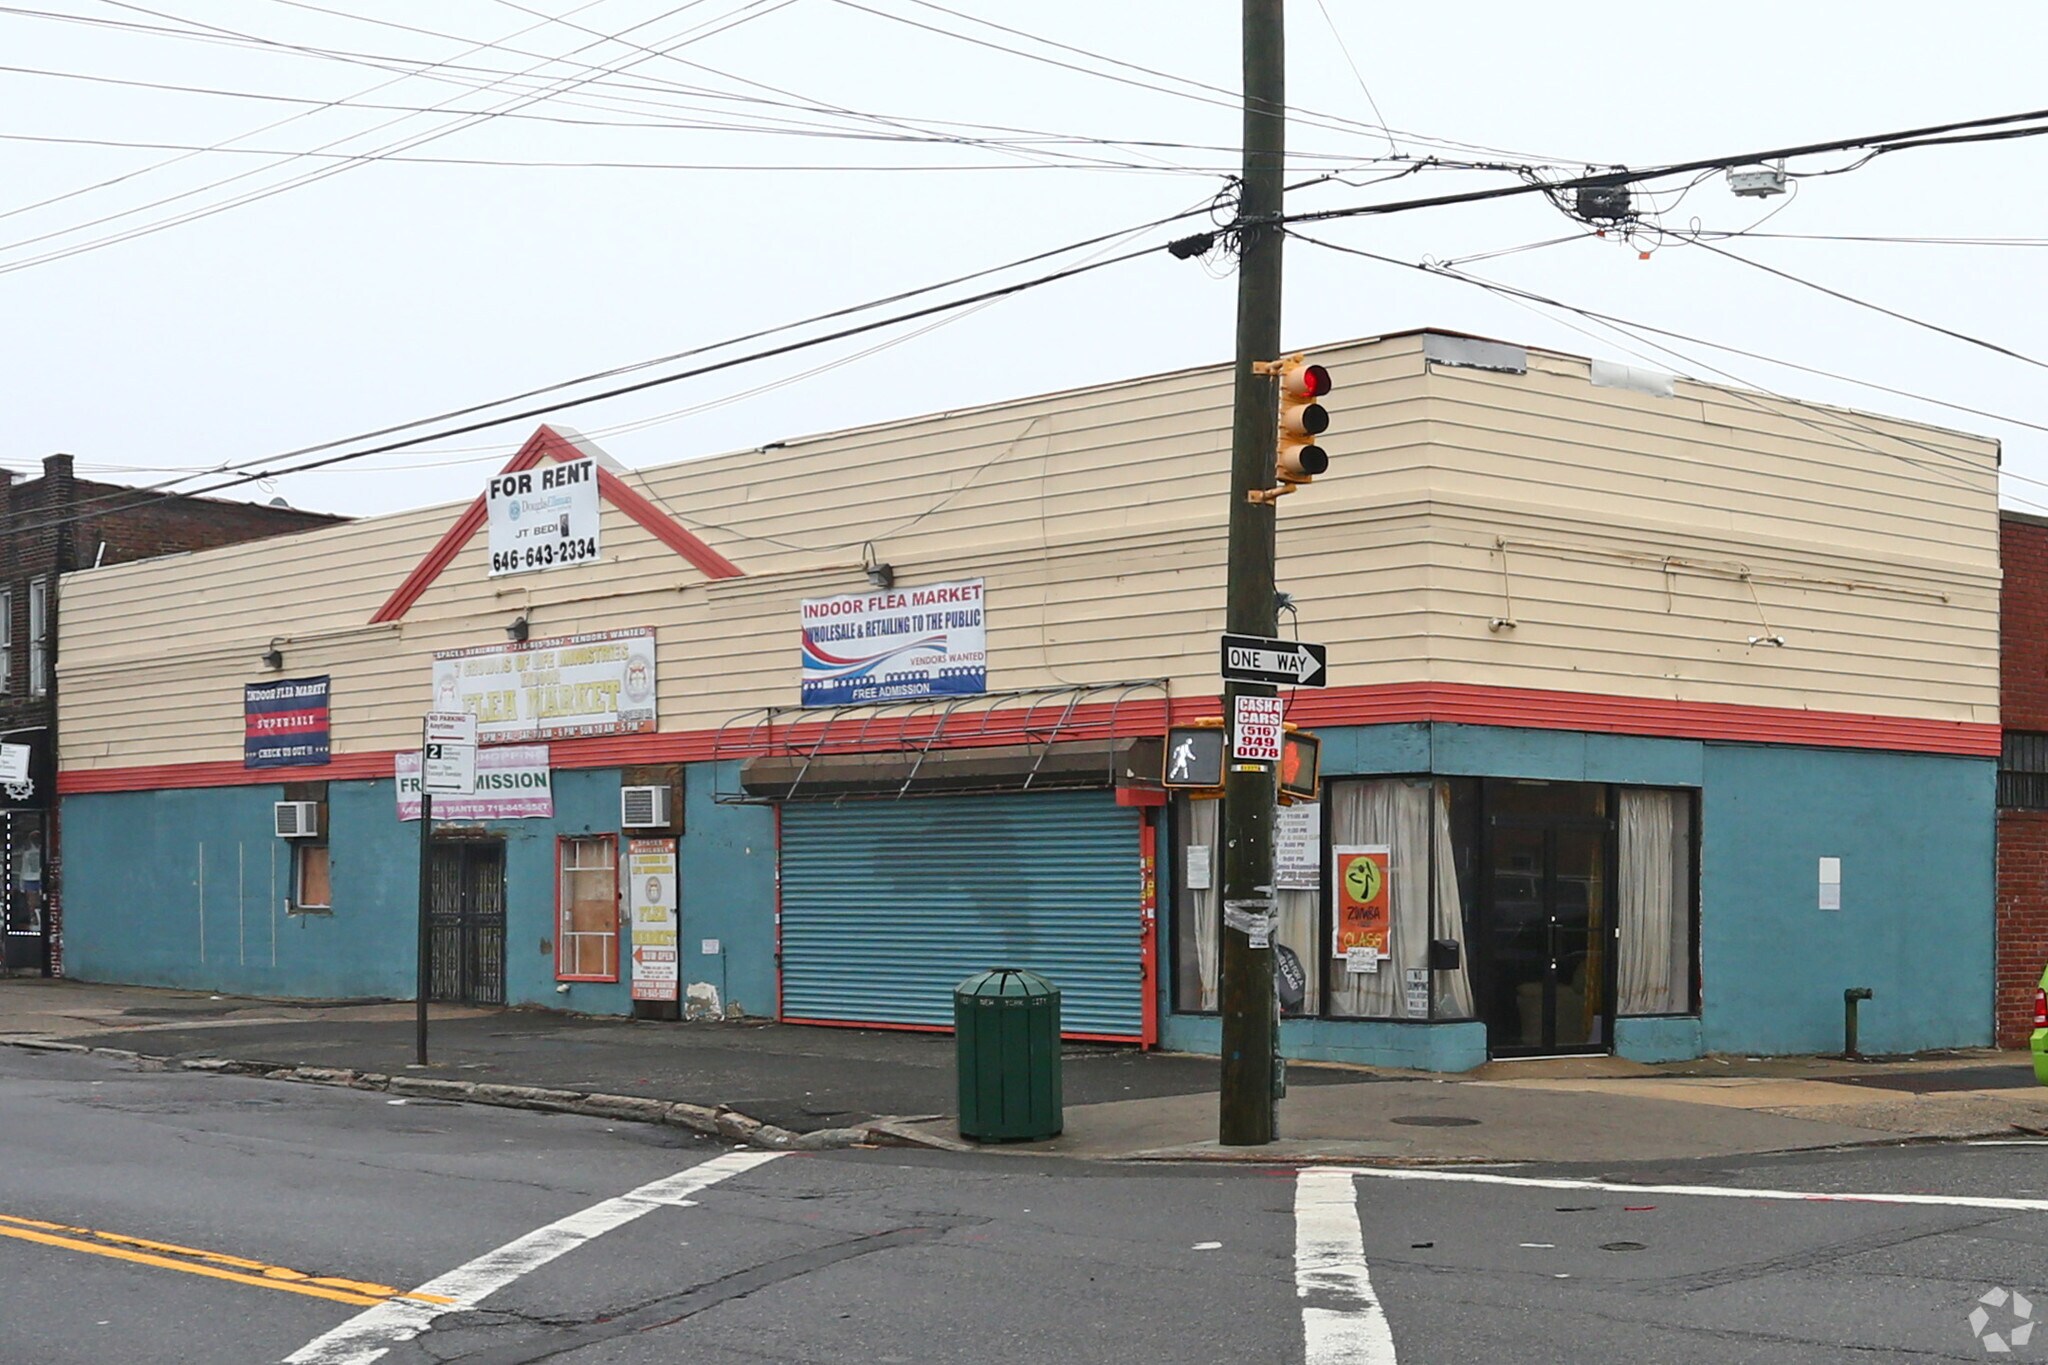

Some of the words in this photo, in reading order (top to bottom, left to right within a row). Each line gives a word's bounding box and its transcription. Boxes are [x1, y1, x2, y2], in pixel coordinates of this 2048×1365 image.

[490, 473, 532, 499] FOR
[542, 460, 593, 490] RENT
[515, 529, 529, 539] JT
[534, 524, 558, 536] BEDI
[493, 537, 596, 572] 646-643-2334
[804, 601, 863, 618] INDOOR
[868, 594, 907, 612] FLEA
[912, 584, 982, 606] MARKET
[806, 622, 856, 644] WHOLESALE
[858, 624, 863, 638] &
[866, 616, 910, 638] RETAILING
[912, 615, 924, 631] TO
[926, 613, 943, 630] THE
[945, 608, 981, 628] PUBLIC
[910, 654, 947, 666] VENDORS
[949, 652, 984, 662] WANTED
[1231, 650, 1261, 668] ONE
[1277, 654, 1307, 672] WAY
[246, 688, 276, 702] INDOOR
[276, 687, 294, 698] FLEA
[295, 682, 326, 696] MARKET
[852, 688, 877, 700] FREE
[878, 682, 930, 698] ADMISSION
[462, 689, 518, 724] FLEA
[526, 679, 621, 720] MARKET
[1238, 712, 1280, 725] CARS
[1241, 725, 1277, 736] (516)
[1242, 736, 1275, 746] 949
[258, 748, 282, 758] CHECK
[292, 746, 306, 756] OUT
[429, 745, 438, 758] 2
[479, 750, 545, 762] HOPPING
[1238, 746, 1278, 758] 0078
[400, 778, 422, 792] FR
[476, 772, 547, 790] MISSION
[446, 804, 484, 813] WANTED
[1347, 906, 1380, 920] ZUMBA
[1343, 932, 1382, 948] CLASS
